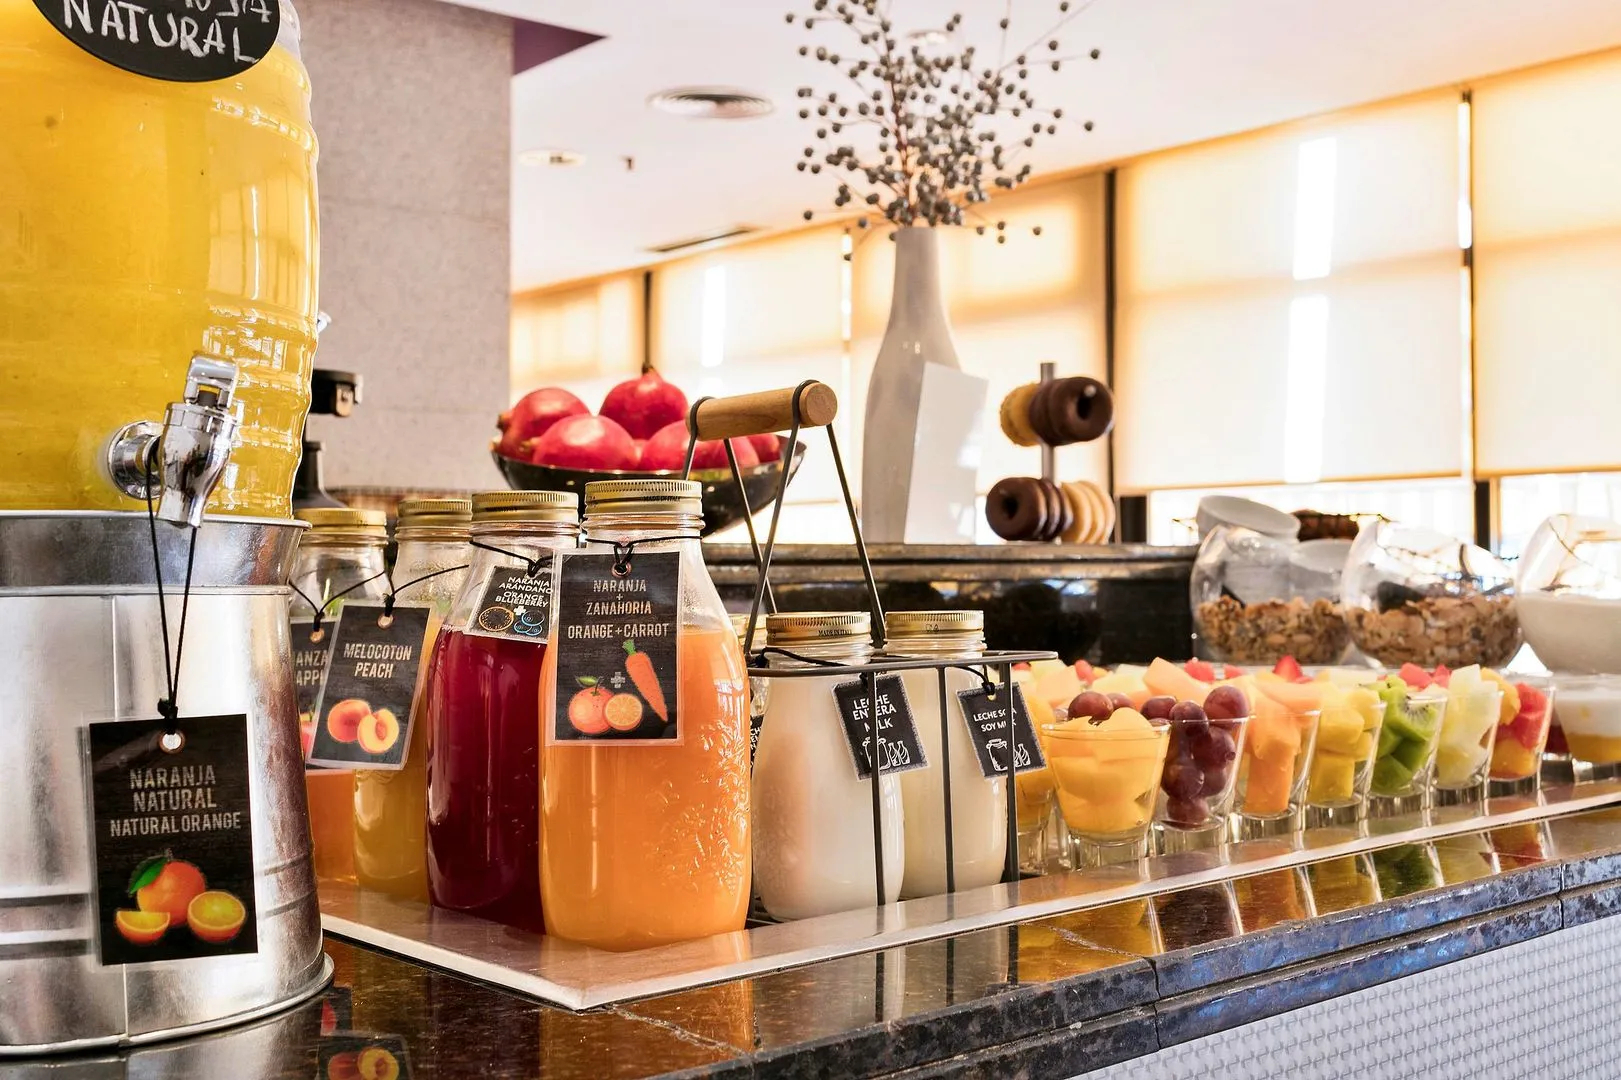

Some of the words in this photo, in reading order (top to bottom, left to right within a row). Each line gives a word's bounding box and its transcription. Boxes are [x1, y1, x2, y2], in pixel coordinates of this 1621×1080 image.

[63, 0, 260, 63] NATURAL
[508, 576, 549, 588] NARANJA
[593, 579, 647, 592] NARANJA
[495, 595, 549, 608] BLUEBERRY
[503, 591, 544, 601] ORANGE
[586, 601, 652, 616] ZANAHORIA
[343, 643, 412, 661] MELOCOTON
[354, 662, 394, 679] PEACH
[852, 705, 897, 720] ENERA
[973, 710, 998, 722] LECHE
[981, 722, 996, 733] SOY
[130, 764, 216, 789] NARANJA
[133, 788, 217, 813] NATURAL
[110, 816, 179, 837] NATURAL
[181, 811, 242, 832] ORANGE
